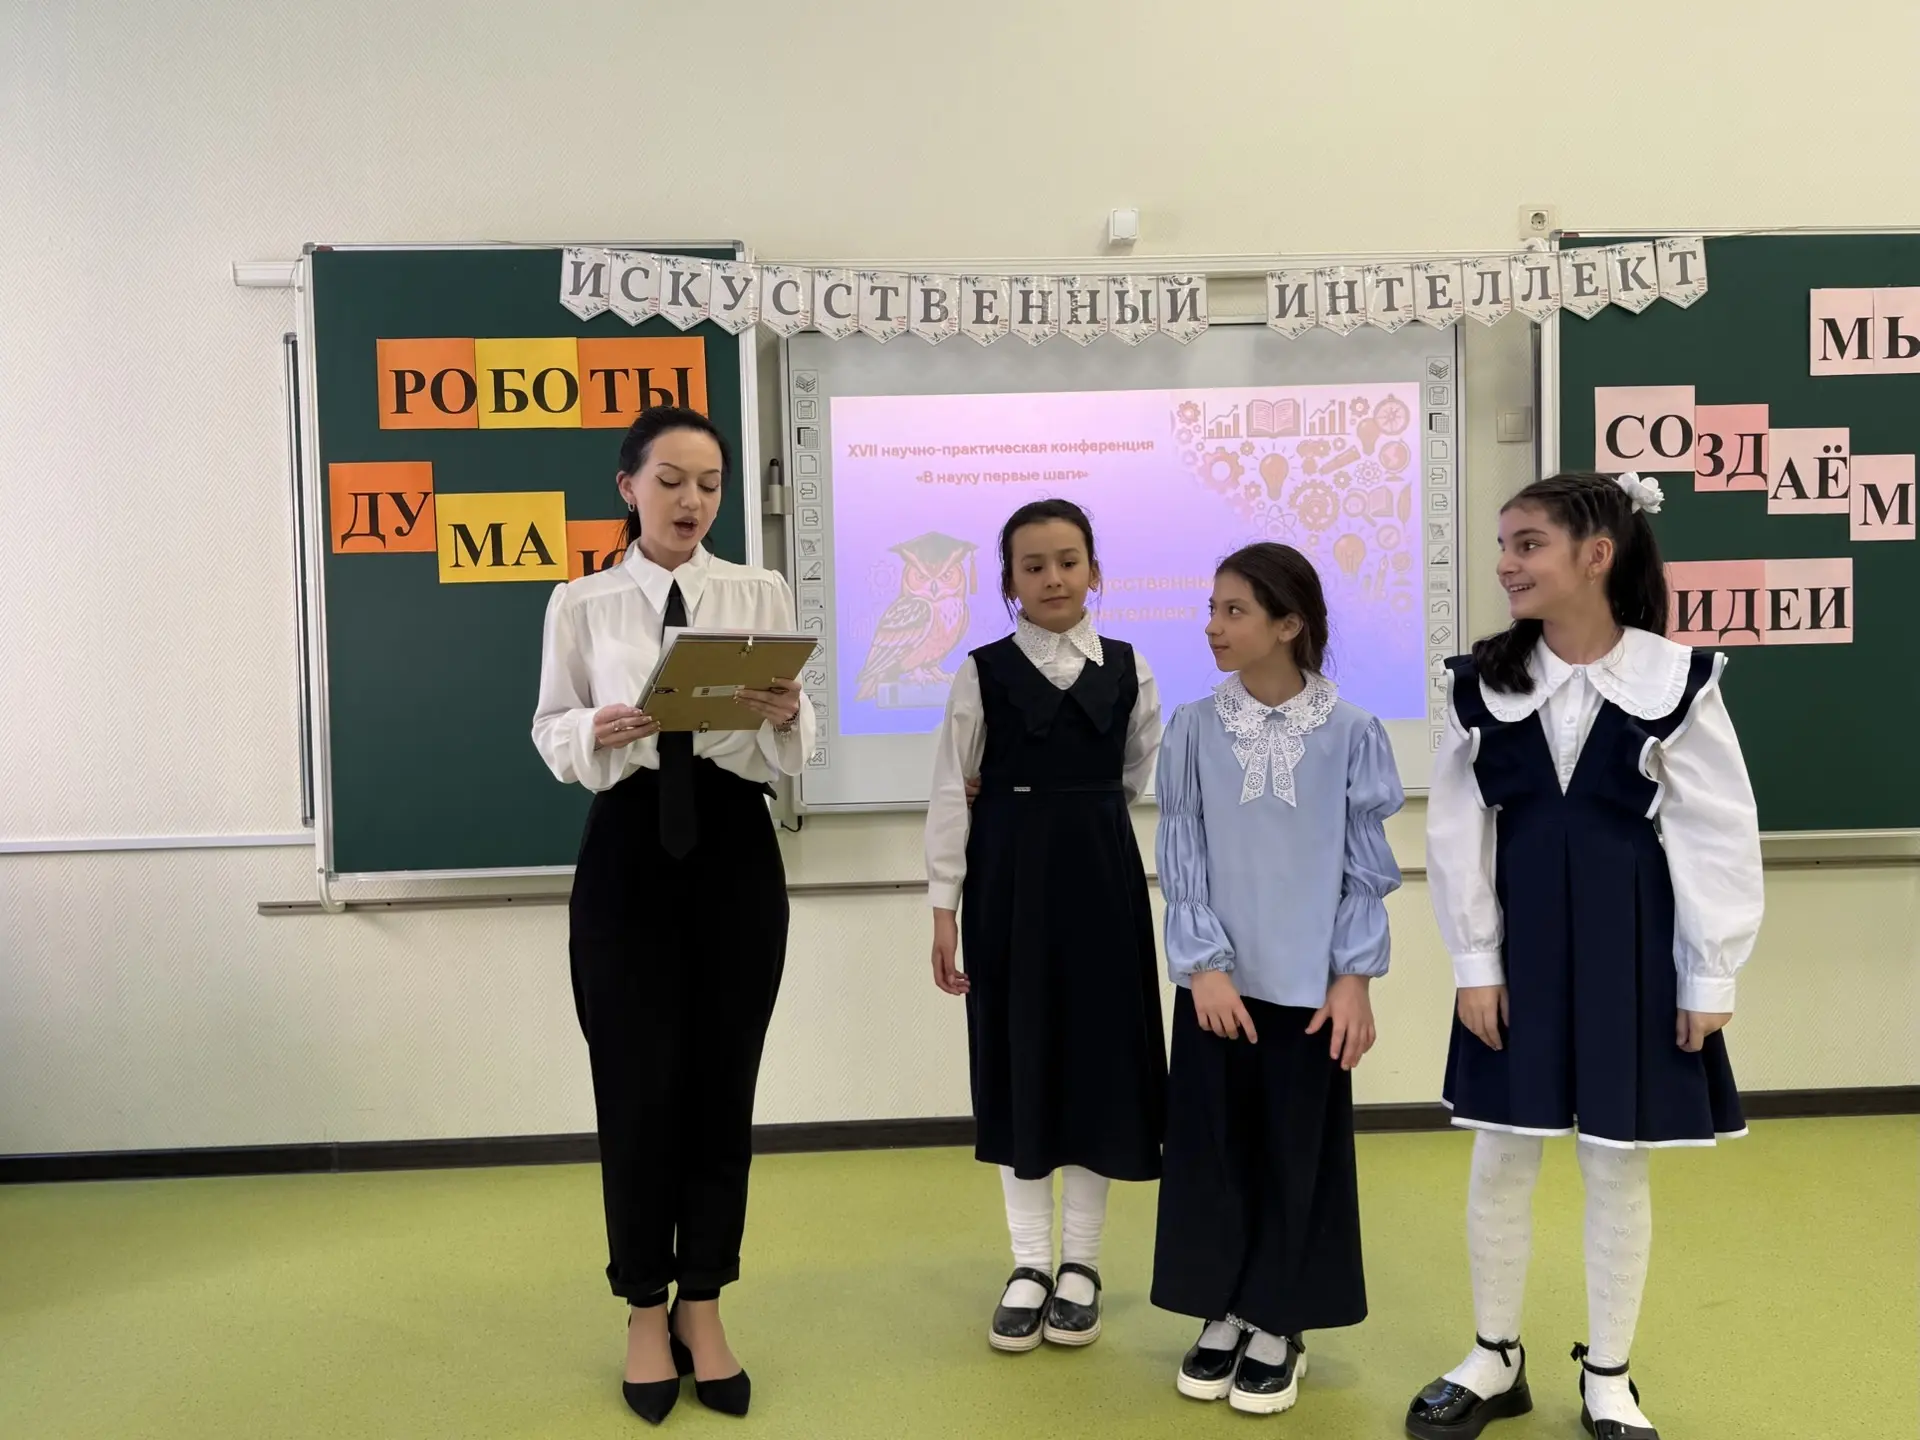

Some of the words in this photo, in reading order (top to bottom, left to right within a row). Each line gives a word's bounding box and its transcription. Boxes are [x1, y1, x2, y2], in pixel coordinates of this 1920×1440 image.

[569, 261, 1202, 325] ИСКУССТВЕННЫЙ
[1275, 250, 1698, 319] ИНТЕЛЛЕКТ
[389, 366, 693, 414] РОБОТЫ
[847, 444, 878, 458] XVII
[881, 442, 1048, 459] научно-практическая
[1051, 439, 1154, 455] конференция
[1604, 414, 1914, 527] СОЗДАЁМ
[916, 470, 934, 484] «В
[937, 472, 980, 486] науку
[983, 471, 1040, 484] первые
[1043, 469, 1089, 481] шаги»
[1673, 586, 1851, 643] ИДЕИ
